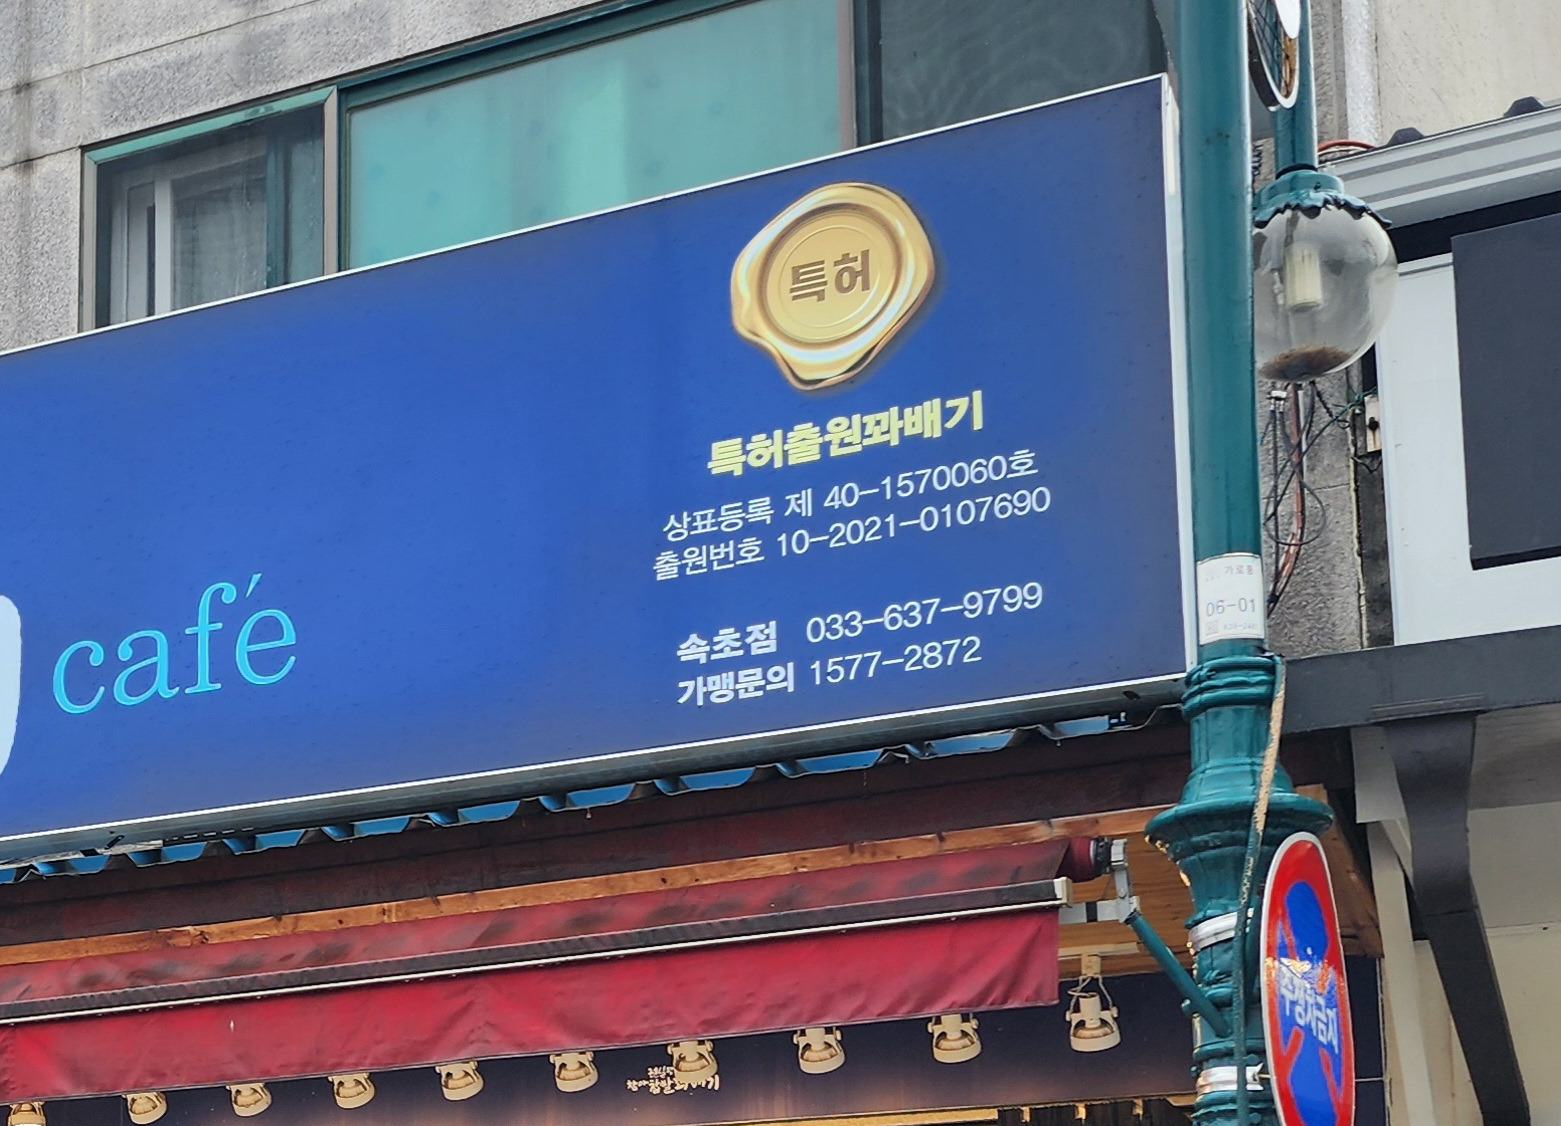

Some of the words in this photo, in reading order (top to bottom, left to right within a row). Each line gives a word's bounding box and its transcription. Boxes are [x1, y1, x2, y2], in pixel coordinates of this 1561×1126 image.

[790, 249, 870, 302] 특허
[707, 390, 984, 475] 특허출원꽈배기
[653, 535, 765, 581] 출원번호
[777, 487, 1051, 557] 10-2021-0107690
[663, 496, 775, 541] 상표등록
[784, 488, 813, 519] 제
[823, 448, 1039, 509] 40-1570060호
[52, 573, 297, 714] café
[676, 621, 778, 664] 속초점
[806, 582, 1043, 643] 033-637-9799
[1206, 597, 1256, 617] 06-01
[677, 662, 795, 706] 가맹문의
[810, 636, 982, 684] 1577-2872
